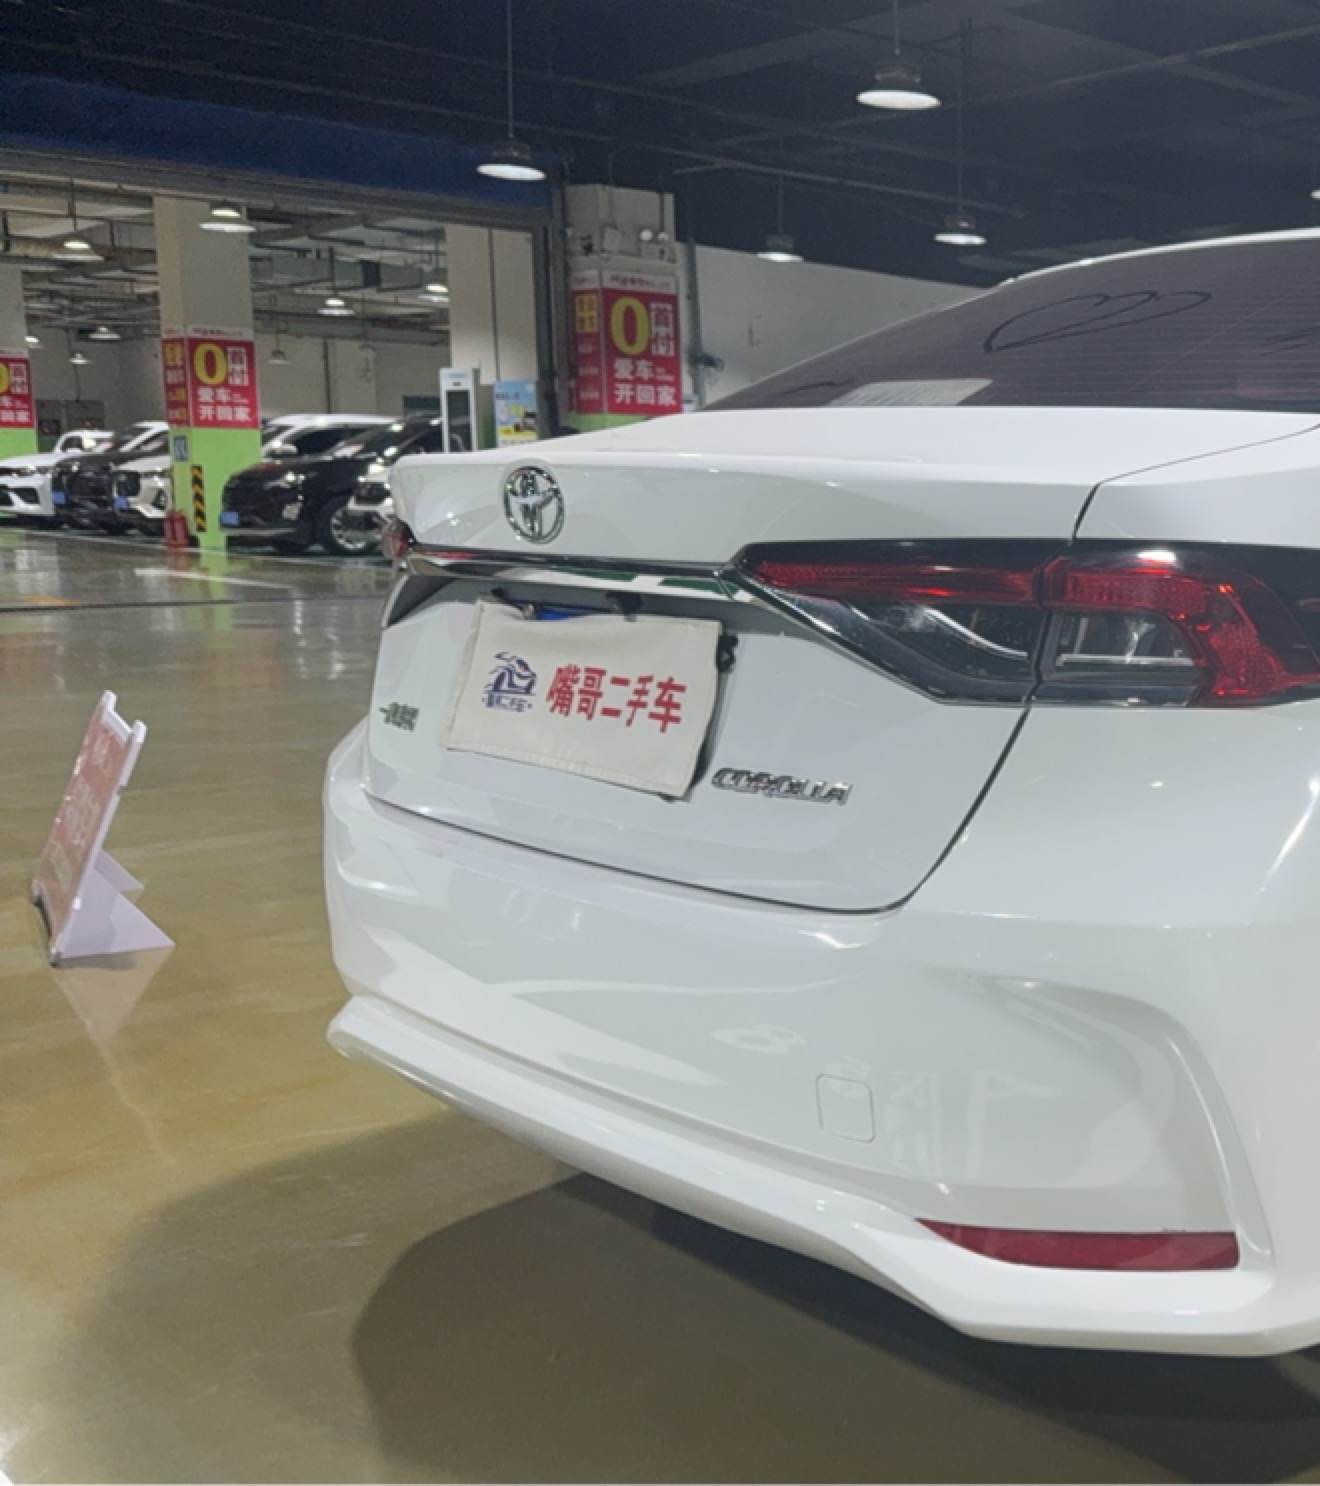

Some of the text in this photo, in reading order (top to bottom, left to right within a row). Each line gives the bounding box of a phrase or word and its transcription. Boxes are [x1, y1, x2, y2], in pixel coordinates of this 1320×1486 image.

[546, 664, 686, 733] 嘴哥二手车
